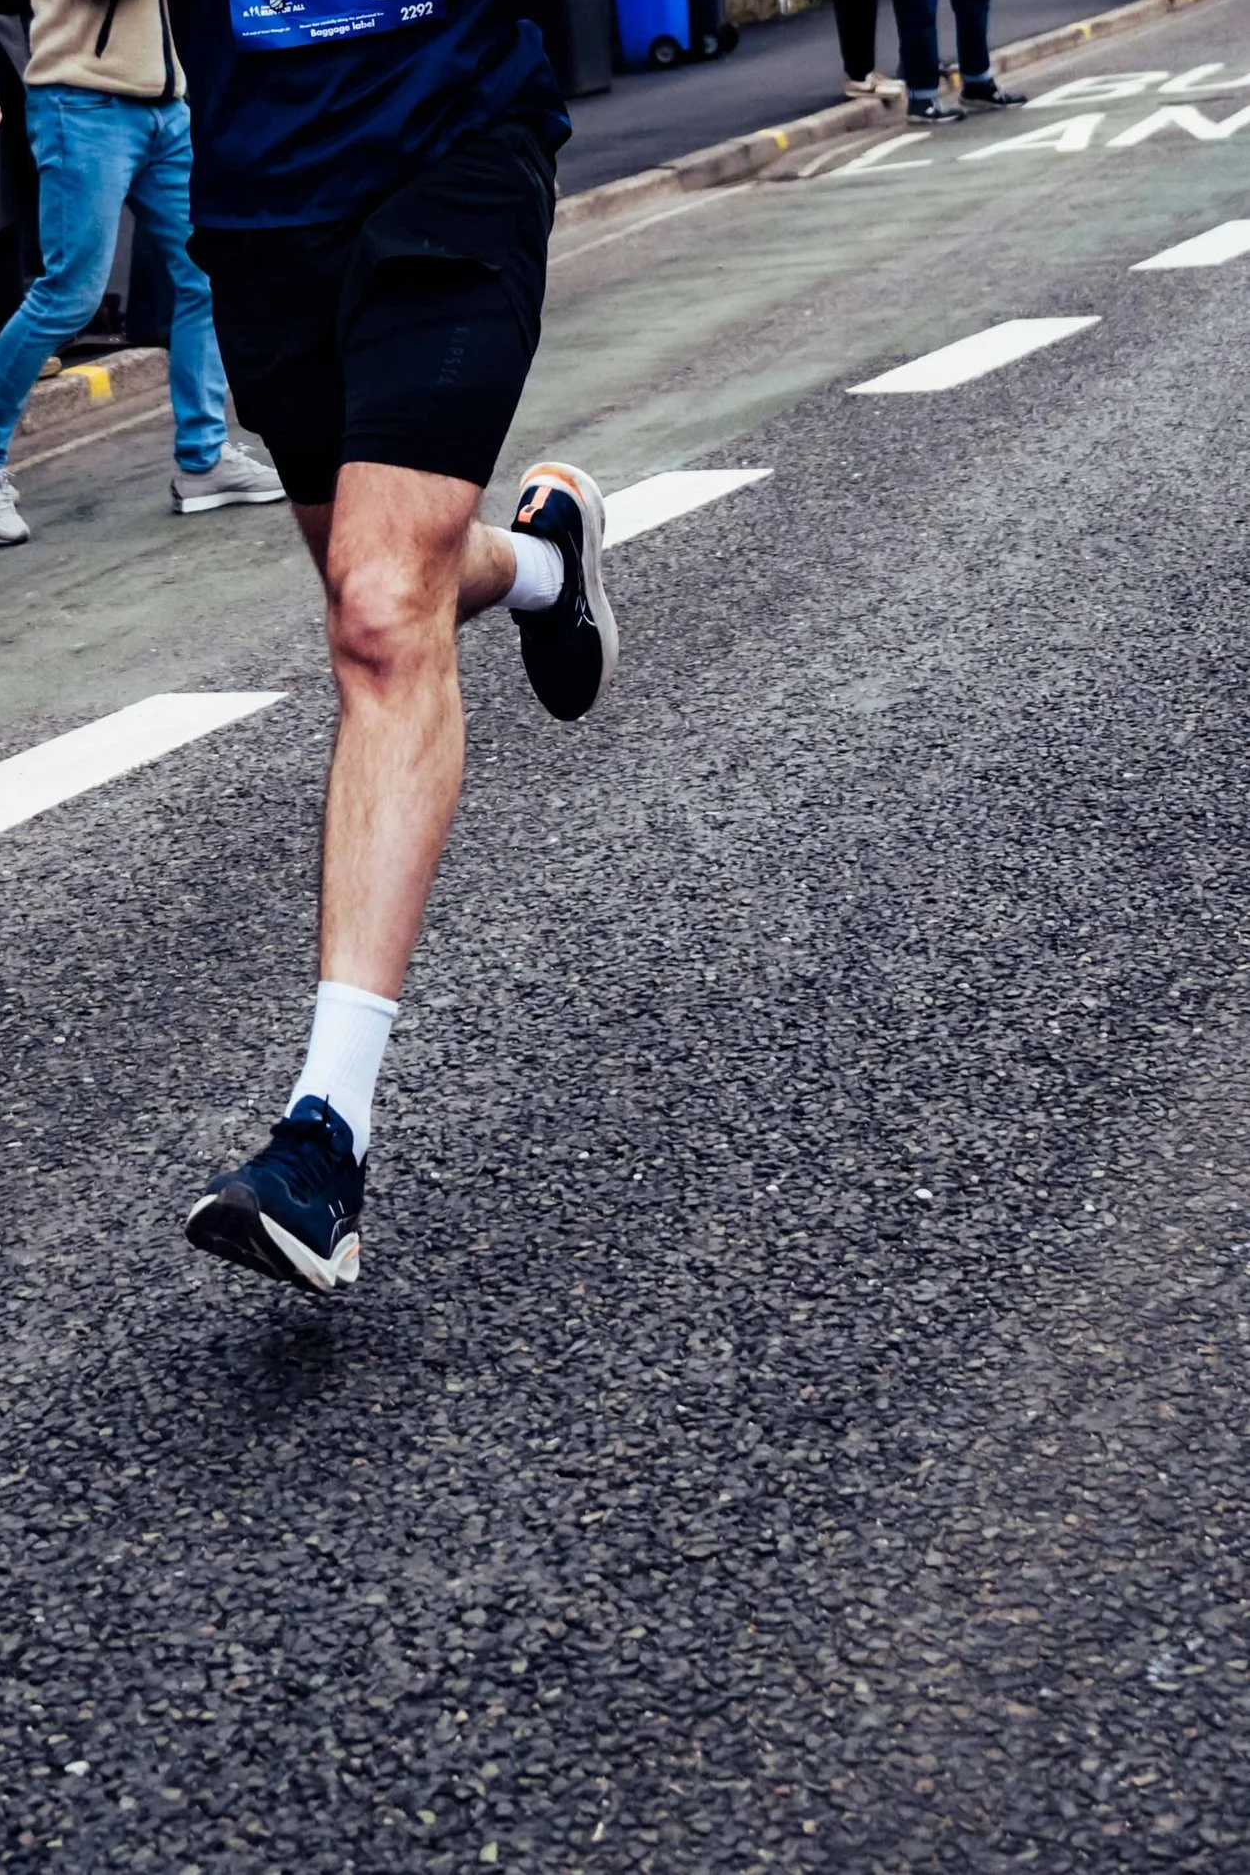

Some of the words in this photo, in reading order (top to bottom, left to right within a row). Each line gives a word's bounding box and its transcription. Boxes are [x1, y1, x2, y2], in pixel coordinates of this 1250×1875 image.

[310, 25, 351, 37] Baggage
[352, 18, 375, 31] label
[400, 1, 434, 21] 2292
[1021, 62, 1250, 109] BU
[825, 105, 1250, 178] LAN
